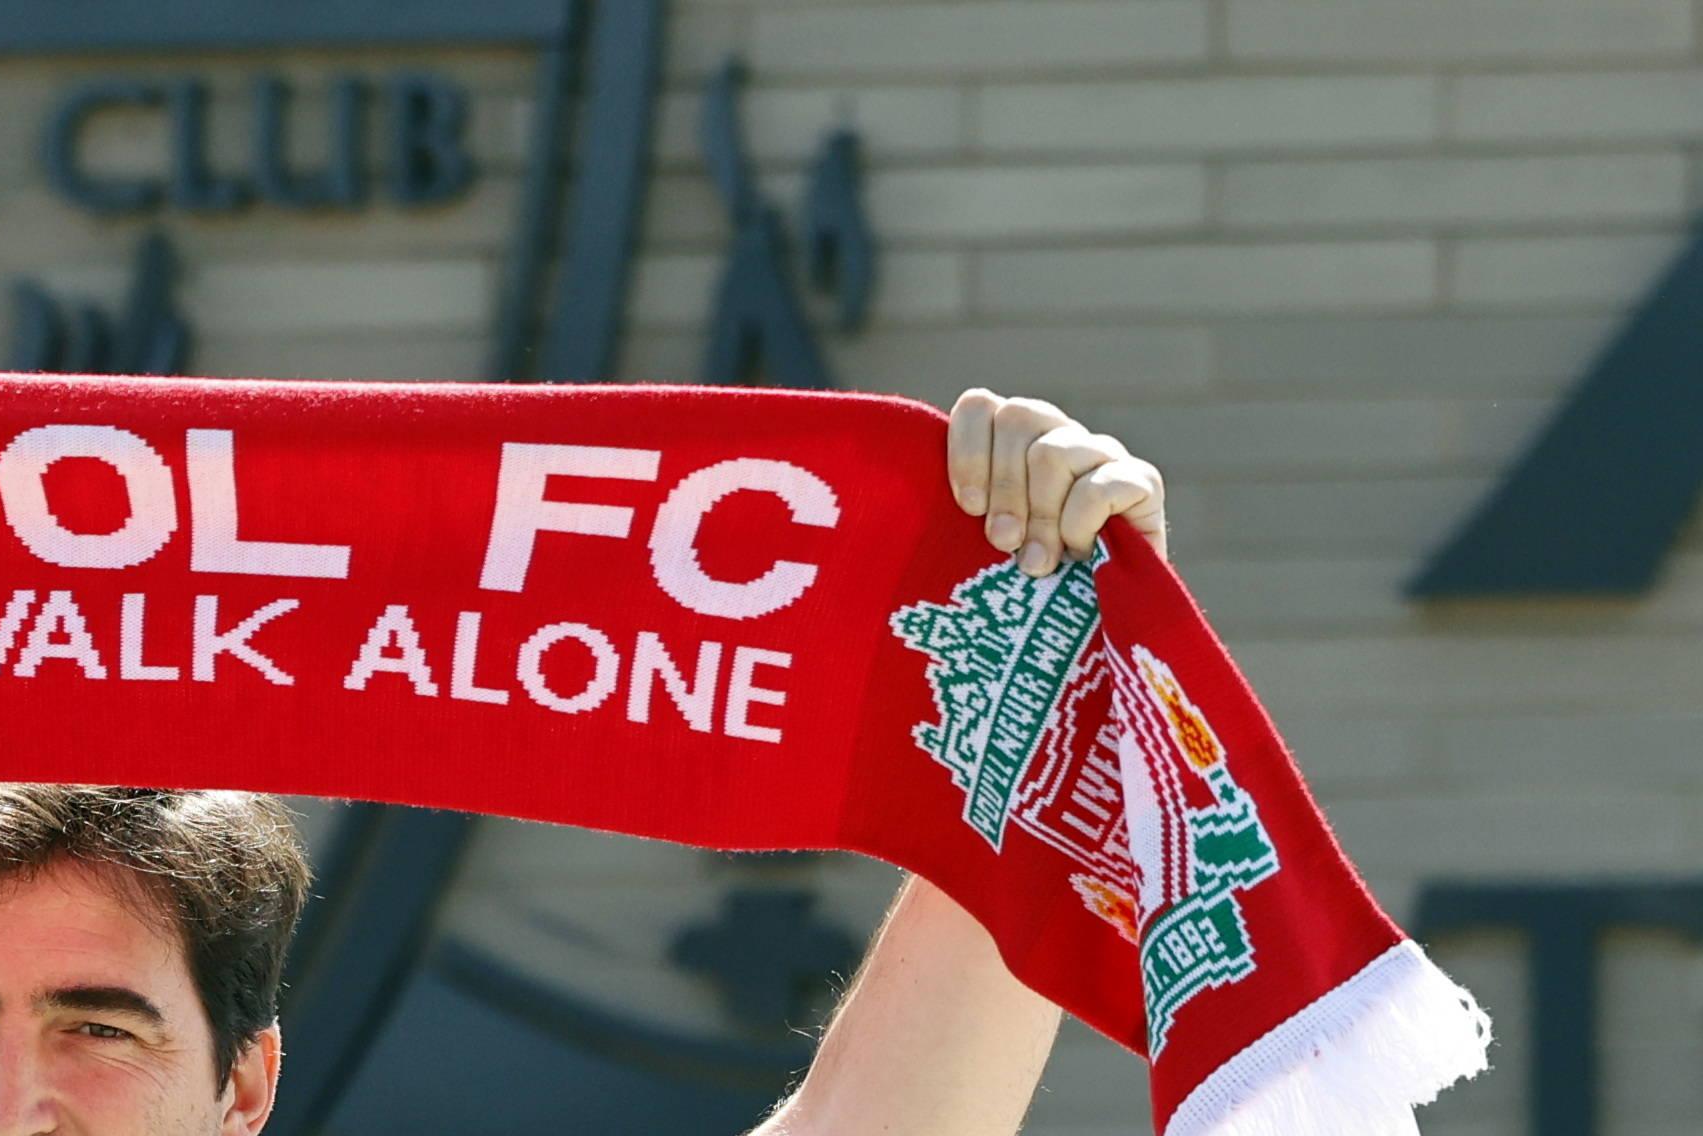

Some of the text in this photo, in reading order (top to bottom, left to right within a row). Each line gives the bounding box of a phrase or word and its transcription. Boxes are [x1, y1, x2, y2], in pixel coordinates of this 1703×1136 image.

[44, 70, 477, 217] CLUB
[480, 443, 840, 620] FC
[344, 606, 792, 743] ALONE
[988, 673, 1052, 761] NEVER
[1022, 595, 1089, 676] WALK
[1157, 916, 1227, 975] 1892
